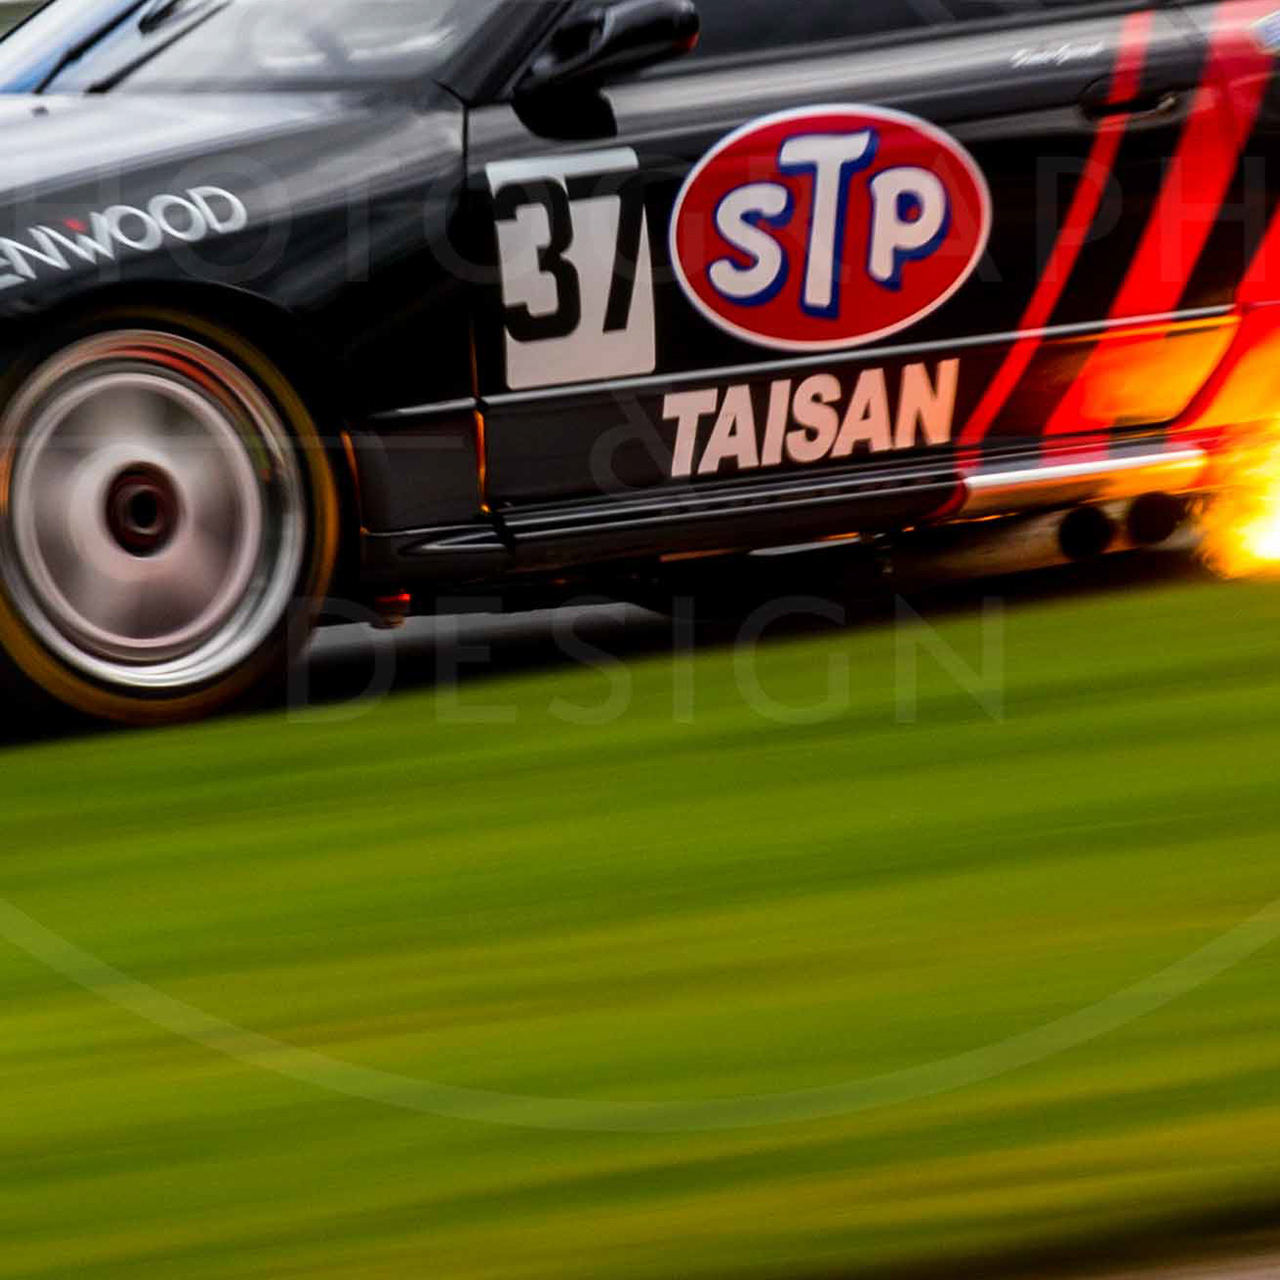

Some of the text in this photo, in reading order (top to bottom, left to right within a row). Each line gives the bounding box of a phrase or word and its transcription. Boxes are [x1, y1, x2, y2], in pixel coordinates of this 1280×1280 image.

[491, 173, 646, 342] 37
[707, 128, 950, 320] STP
[661, 358, 960, 478] TAISAN
